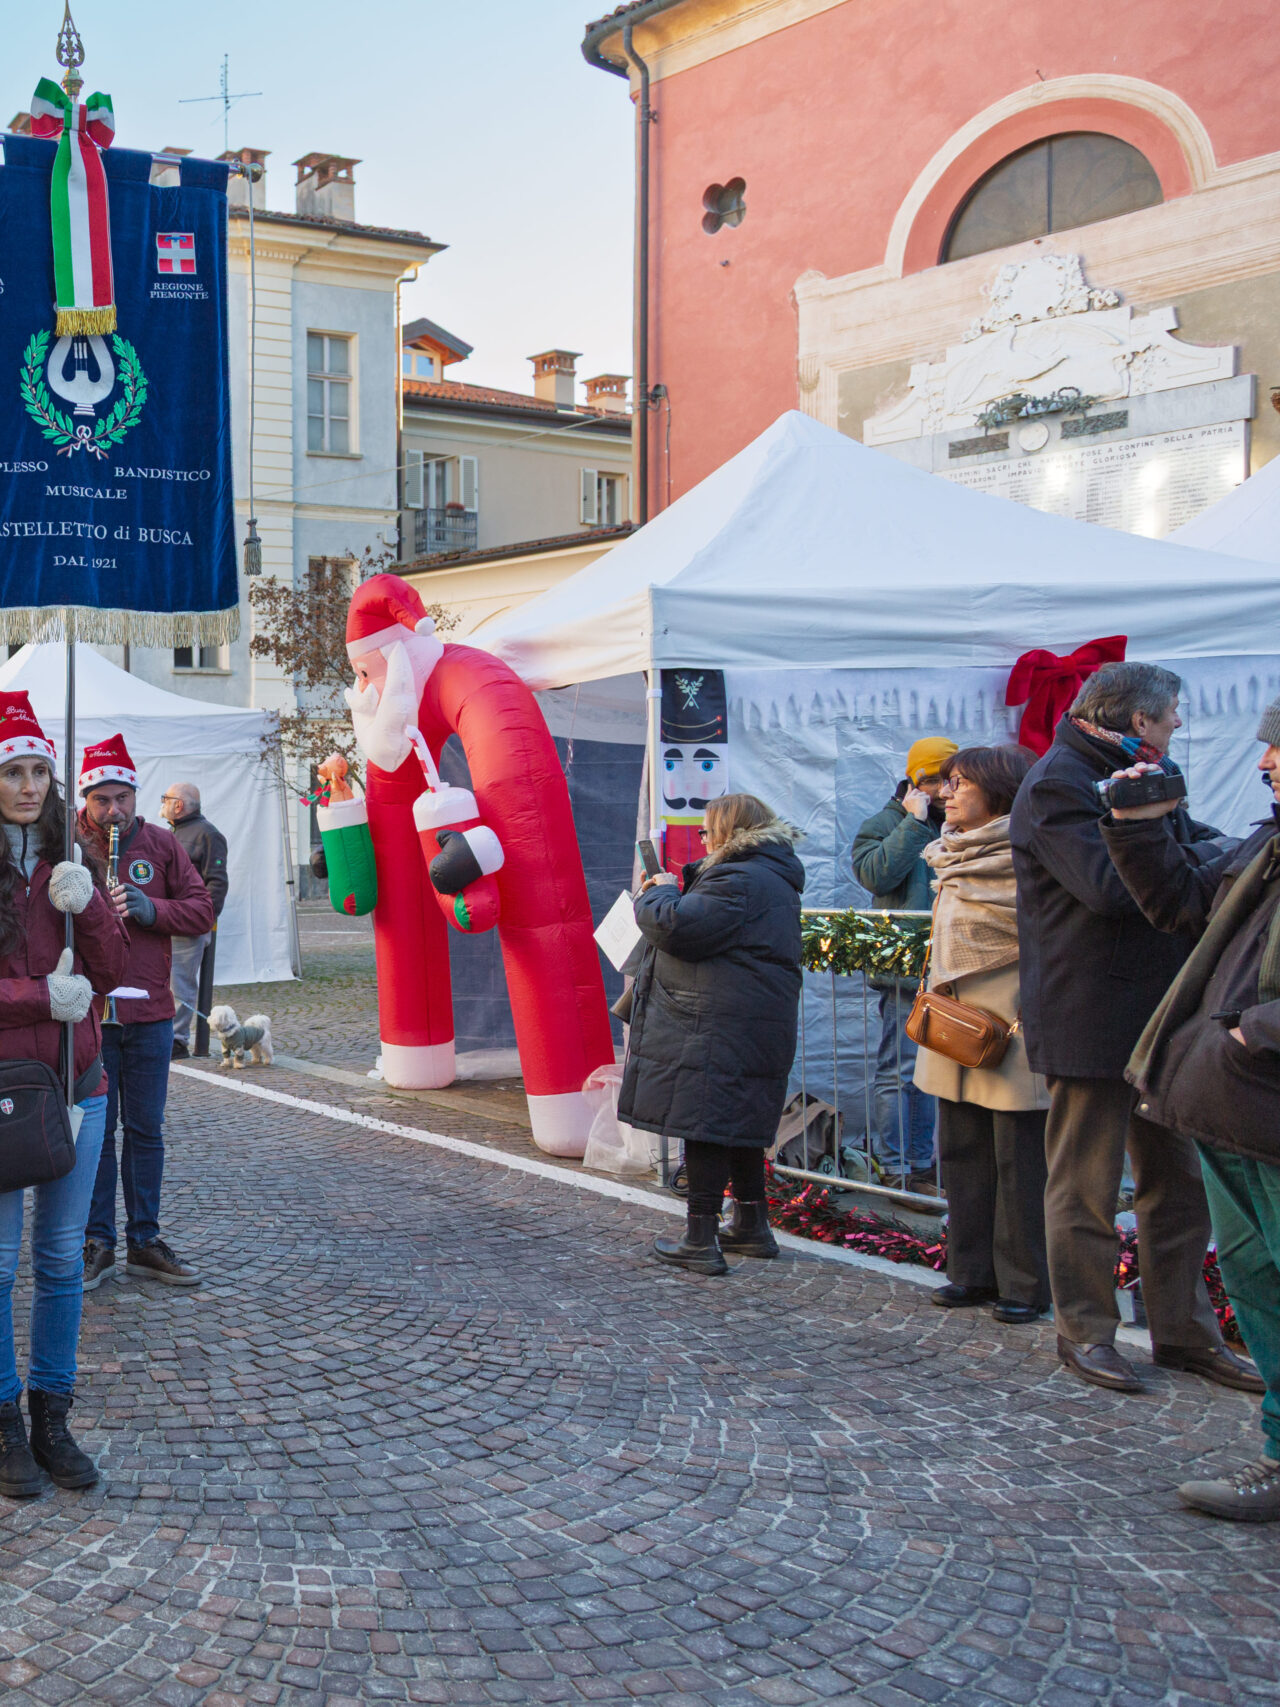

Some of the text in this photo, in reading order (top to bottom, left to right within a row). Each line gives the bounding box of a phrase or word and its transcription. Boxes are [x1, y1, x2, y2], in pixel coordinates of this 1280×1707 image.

[153, 282, 204, 292] REGIONE
[150, 290, 209, 300] PIEMONTE
[1118, 439, 1155, 452] CONFINE
[1163, 433, 1193, 444] DELLA
[1201, 426, 1234, 438] PATRIA
[1093, 452, 1138, 466] GLORIOSA
[114, 467, 211, 481] BANDISTICO
[45, 485, 127, 499] MUSICALE
[114, 526, 130, 540] di
[138, 529, 194, 546] BUSCA
[53, 555, 118, 569] DAL 1921
